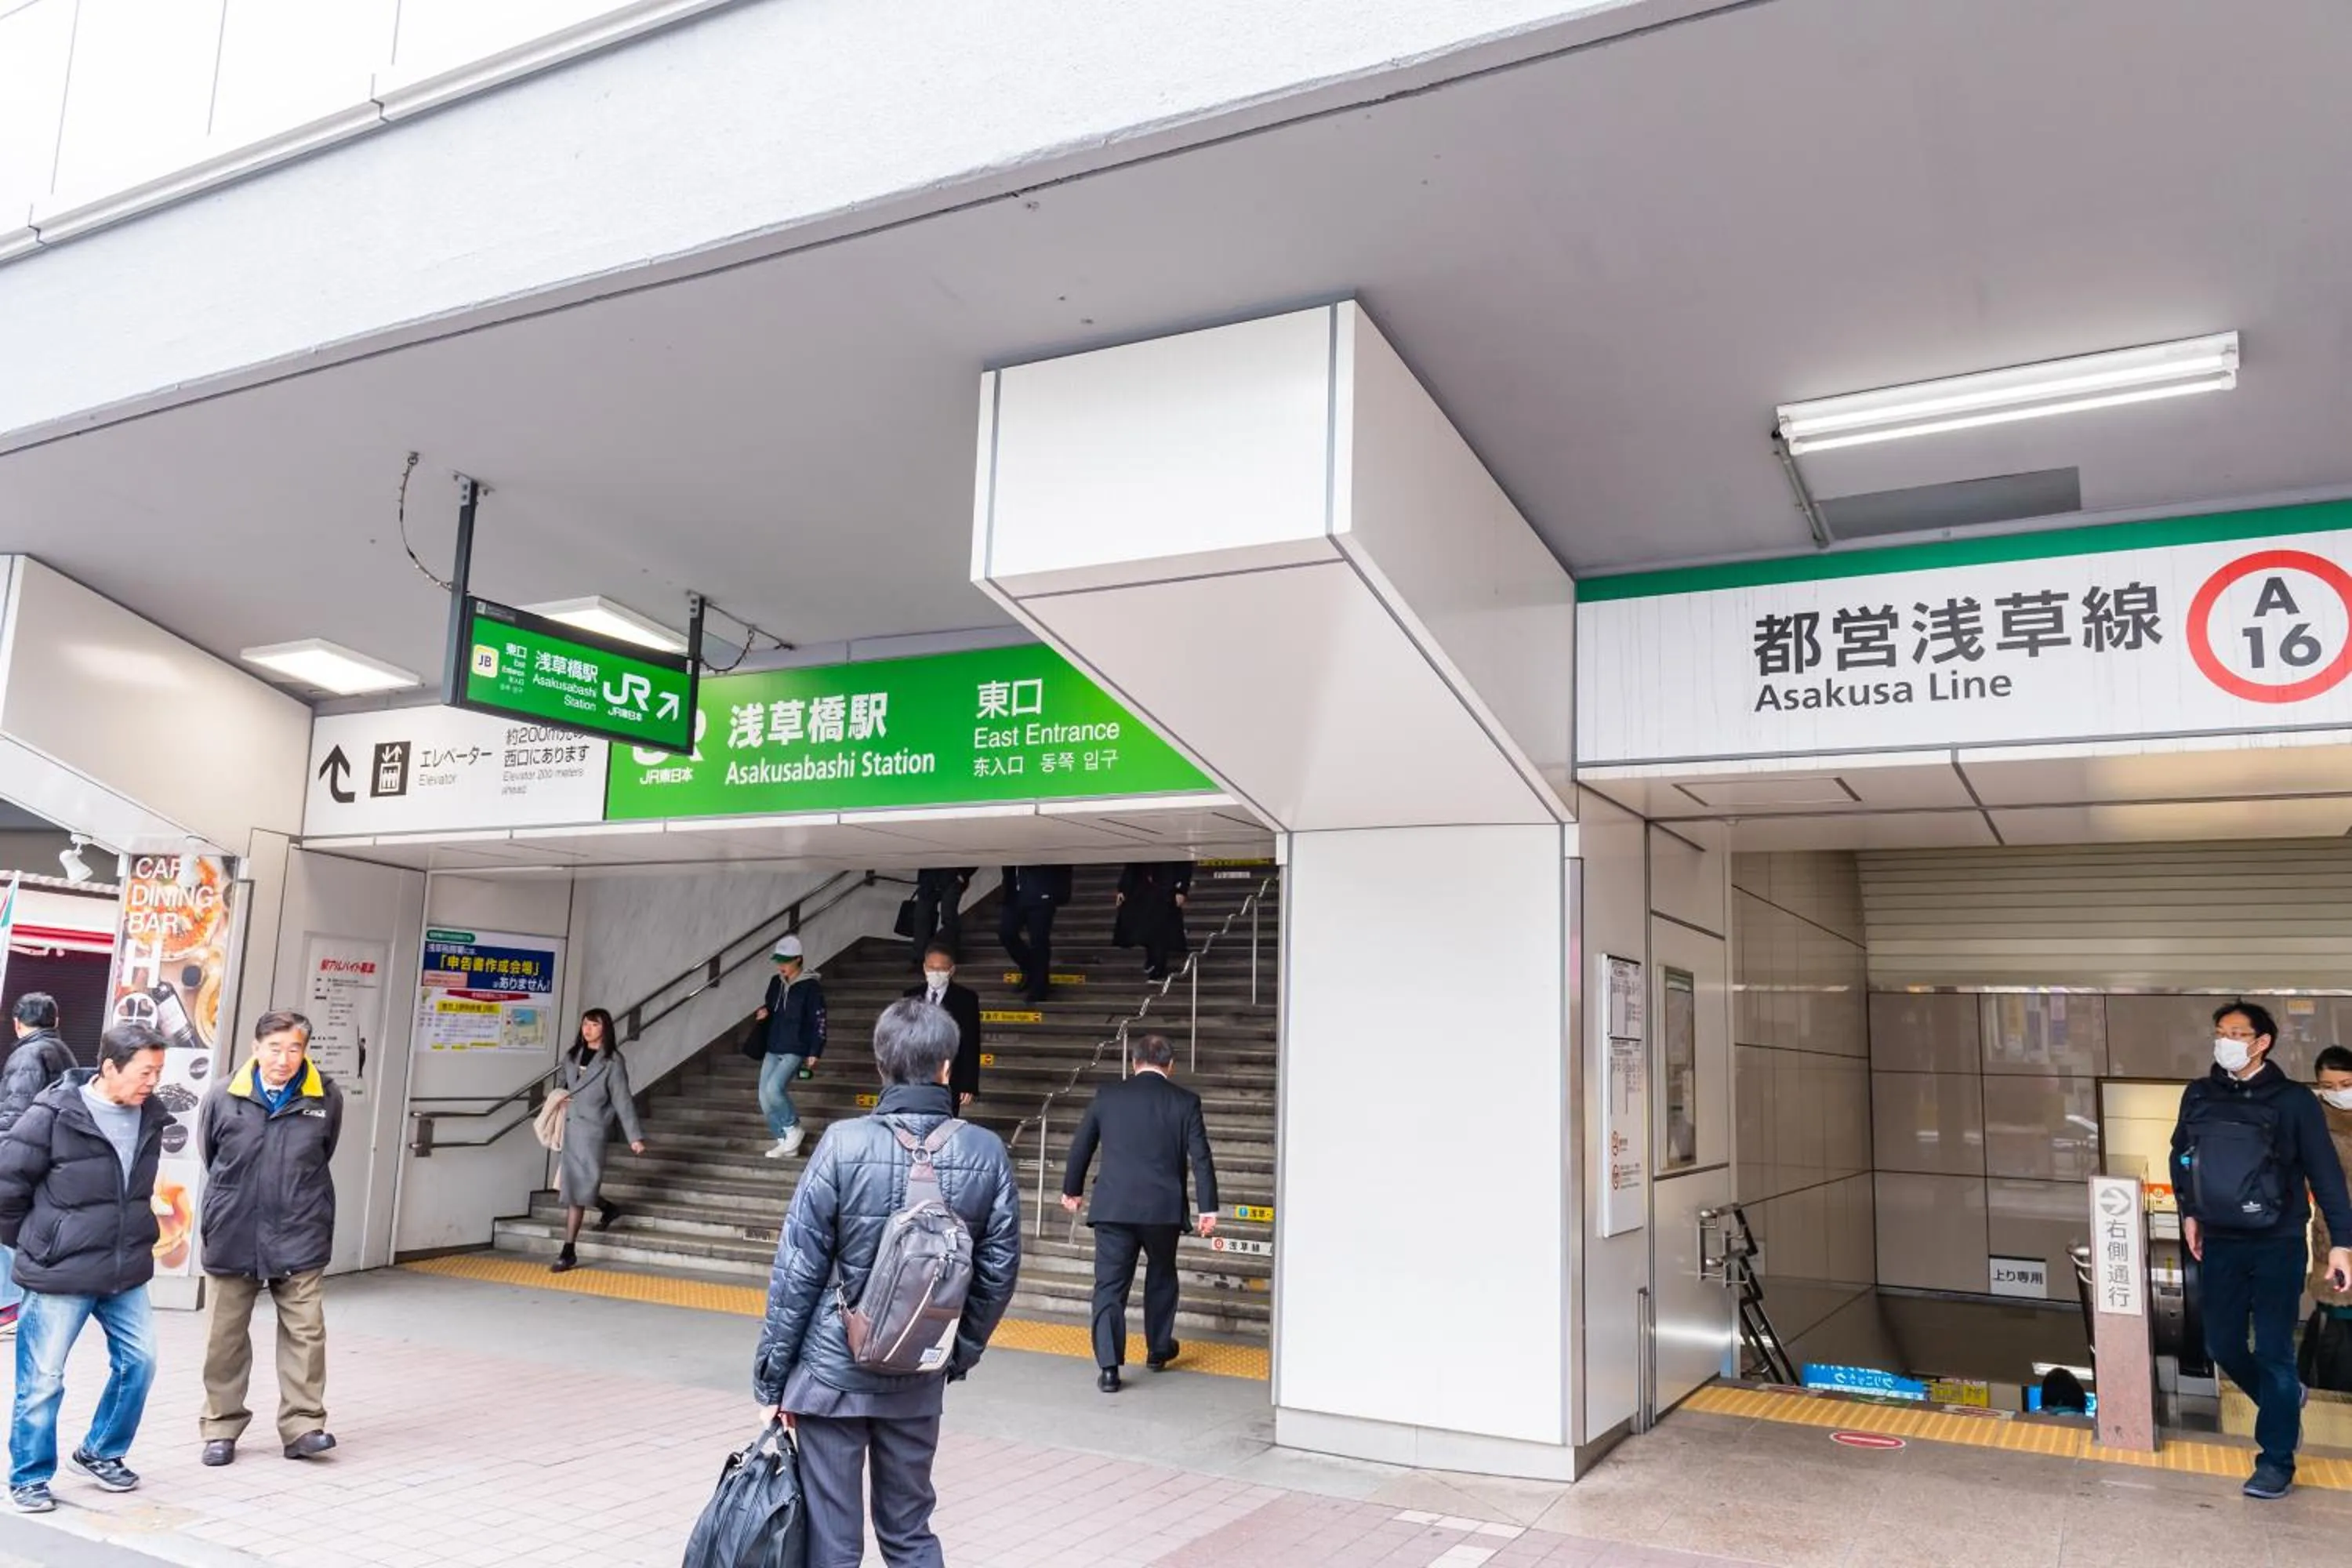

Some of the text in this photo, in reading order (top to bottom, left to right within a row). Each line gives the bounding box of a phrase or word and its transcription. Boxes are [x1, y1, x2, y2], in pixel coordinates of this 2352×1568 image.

[2252, 576, 2300, 617] A
[1754, 582, 2162, 676] 都営浅草線
[506, 642, 527, 659] 東口
[2241, 622, 2322, 669] 16
[478, 655, 492, 666] JB
[535, 650, 598, 684] 浅草橋駅
[533, 673, 597, 698] Asakusabashi
[603, 673, 649, 712] JR
[1754, 670, 2013, 713] Asakusa Line
[564, 694, 597, 711] Station
[975, 678, 1043, 720] 東口
[728, 692, 887, 750] 浅草橋駅
[975, 721, 1120, 749] East Entrance
[420, 745, 492, 768] エレベーター
[504, 745, 590, 768] 西口にあります
[725, 748, 935, 786] Asakusabashi Station
[974, 756, 1024, 777] 东入口
[1041, 749, 1119, 772] 동쪽 입구
[419, 773, 457, 786] Elevator
[639, 767, 694, 785] JR東日本
[131, 884, 215, 908] DINING
[128, 912, 180, 936] BAR
[2106, 1218, 2131, 1308] 右側通行
[1993, 1268, 2044, 1286] 上り専用
